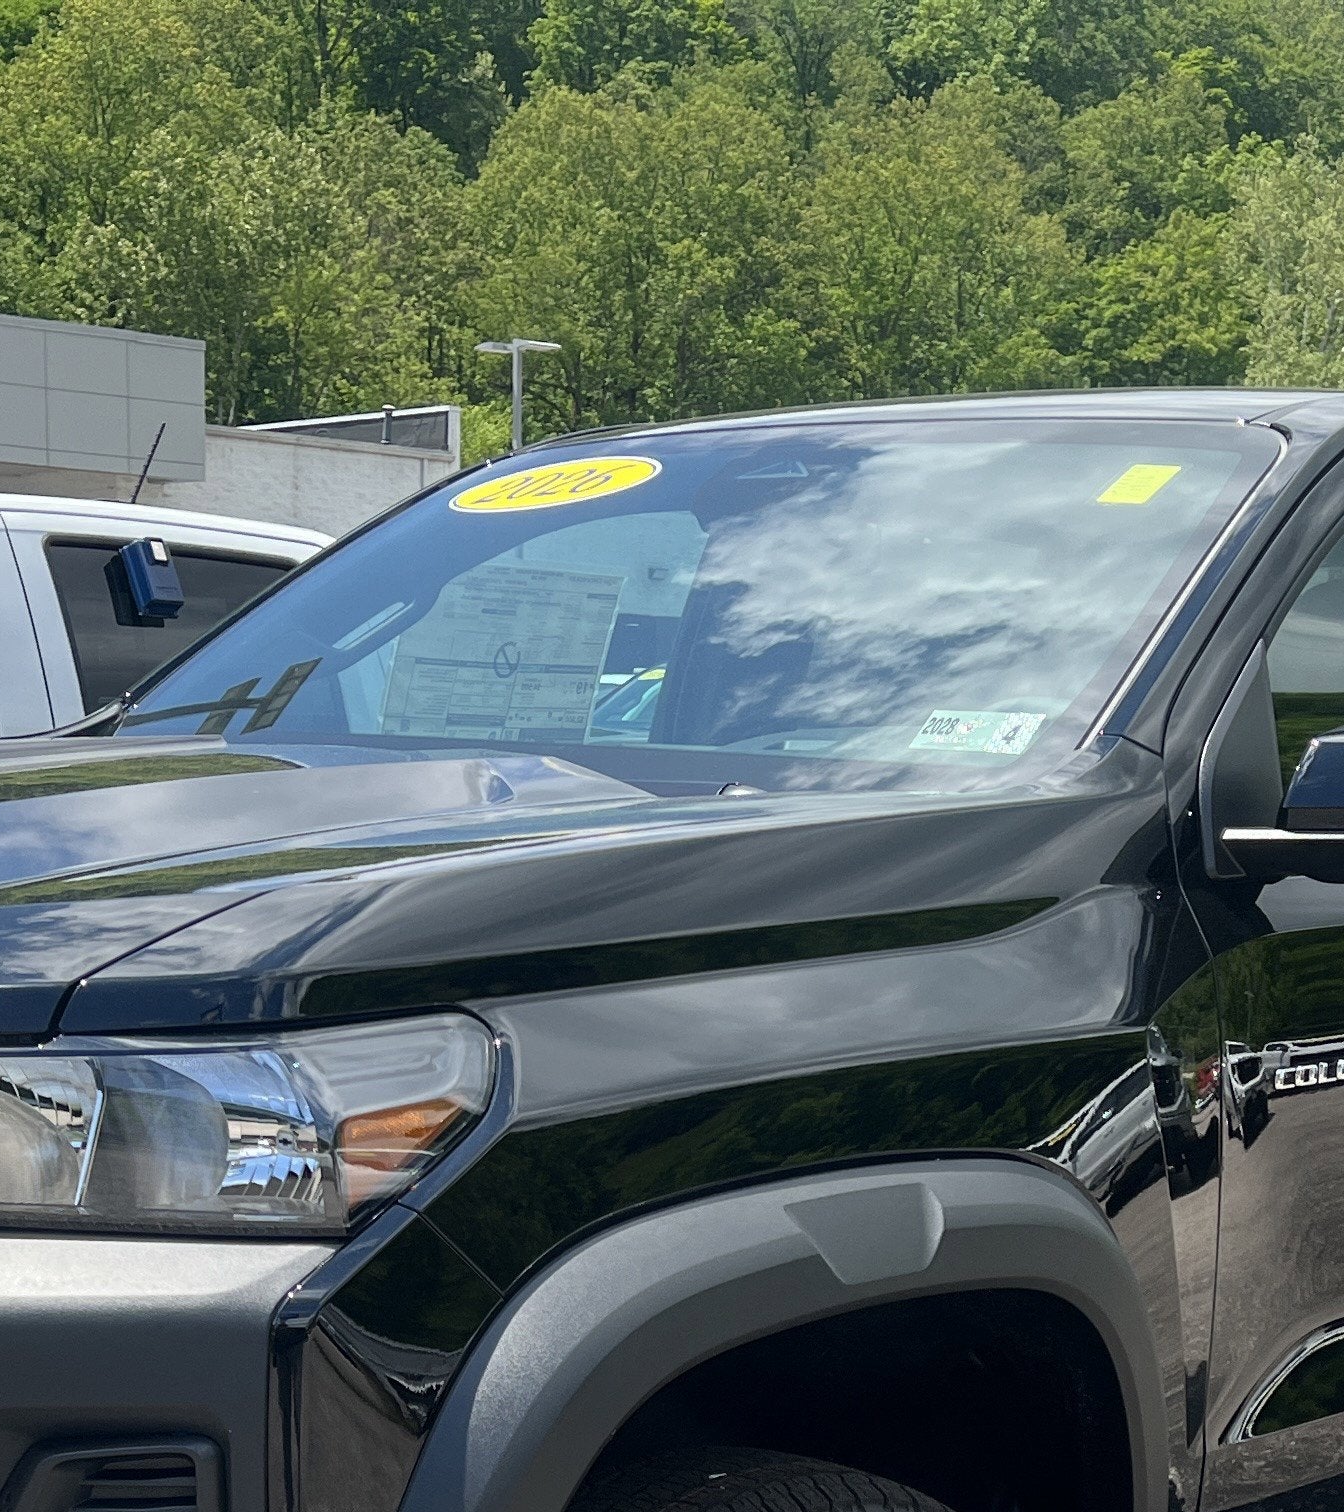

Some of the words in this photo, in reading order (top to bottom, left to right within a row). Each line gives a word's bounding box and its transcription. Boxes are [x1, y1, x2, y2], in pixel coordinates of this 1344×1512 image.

[470, 463, 636, 505] 2026
[922, 717, 960, 735] 2028
[1001, 725, 1021, 744] 4
